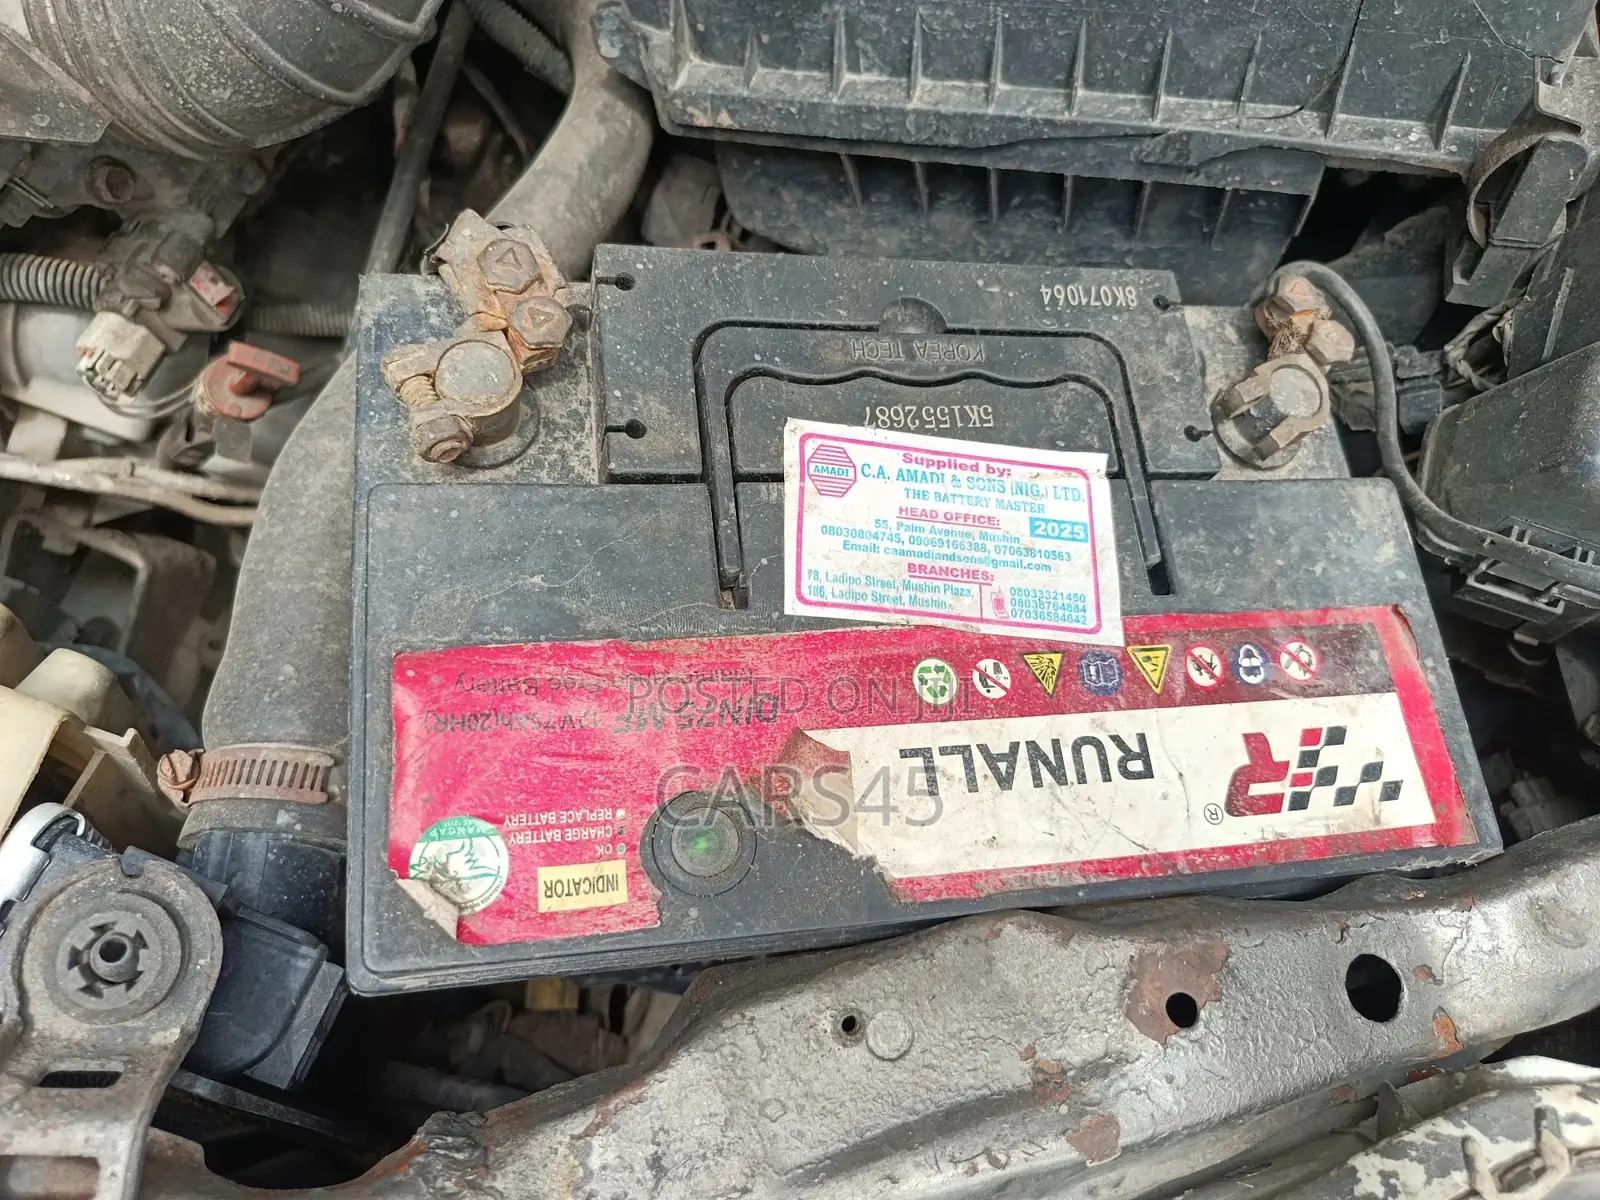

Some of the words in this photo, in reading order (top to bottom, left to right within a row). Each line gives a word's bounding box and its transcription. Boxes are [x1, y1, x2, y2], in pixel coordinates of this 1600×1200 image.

[1040, 284, 1137, 307] 8K071064
[851, 338, 906, 362] TECH
[913, 340, 986, 363] KOREA
[864, 405, 994, 430] 5K1552687
[813, 465, 850, 477] AMADI
[903, 453, 979, 473] Supplied
[986, 464, 1012, 478] by:
[861, 463, 890, 481] C.A.
[896, 468, 945, 484] AMADI
[951, 474, 962, 489] &
[967, 477, 1006, 494] SONS
[1052, 485, 1086, 503] LTD.
[904, 487, 929, 501] THE
[934, 491, 991, 509] BATTERY
[996, 498, 1046, 514] MASTER
[898, 506, 939, 519] HEAD
[944, 511, 1000, 526] OFFICE:
[896, 522, 925, 534] Palm
[929, 525, 975, 540] Avenue,
[979, 530, 1020, 544] Mushin
[1034, 520, 1086, 539] 2025
[842, 539, 880, 554] Email:
[884, 546, 1052, 572] caamadiandsons@gmail.com
[907, 562, 995, 582] BRANCHES:
[825, 571, 862, 588] Ladipo
[865, 574, 899, 590] Street,
[902, 579, 941, 595] Mushin
[944, 584, 974, 600] Plaza,
[831, 586, 868, 603] Ladipo
[454, 672, 539, 696] Battery
[899, 733, 1154, 796] RUNALL
[503, 812, 556, 827] BATTERY
[560, 808, 613, 821] REPLACE
[509, 829, 562, 845] BATTERY
[565, 825, 613, 841] CHARGE
[595, 843, 613, 856] OK
[543, 873, 619, 899] INDICATOR
